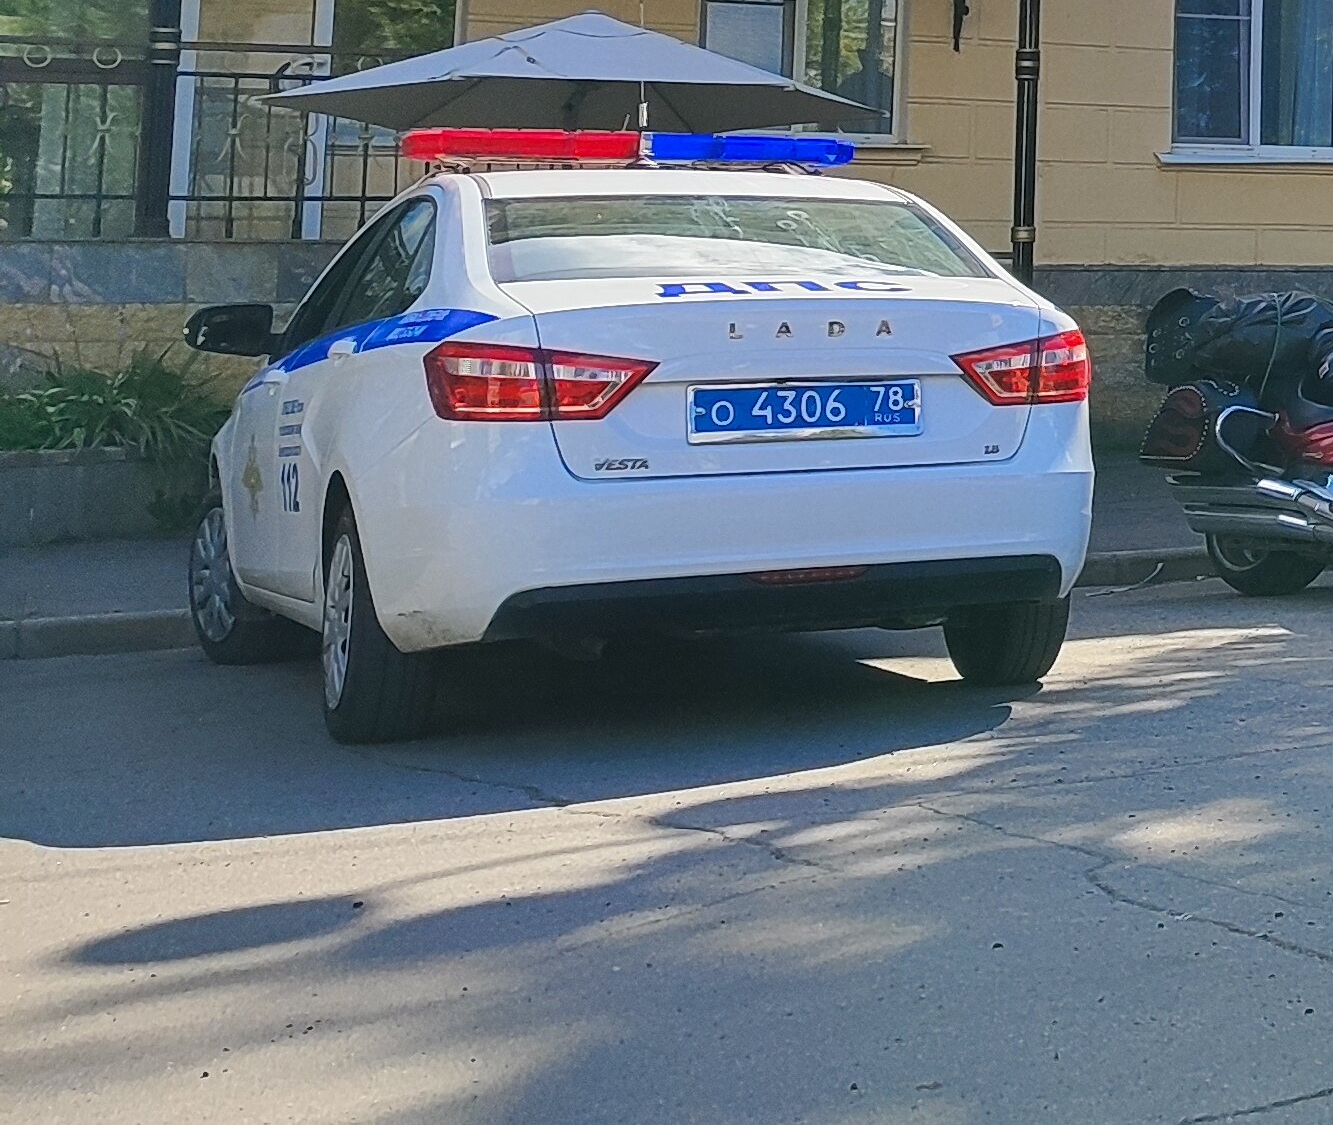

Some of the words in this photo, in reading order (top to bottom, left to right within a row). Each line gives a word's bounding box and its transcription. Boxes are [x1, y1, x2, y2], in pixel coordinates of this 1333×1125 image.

[655, 281, 913, 297] ДПС
[728, 320, 892, 340] LADA
[751, 389, 846, 425] 4306
[869, 386, 904, 412] 78
[874, 413, 901, 423] RUS
[281, 463, 300, 513] 112
